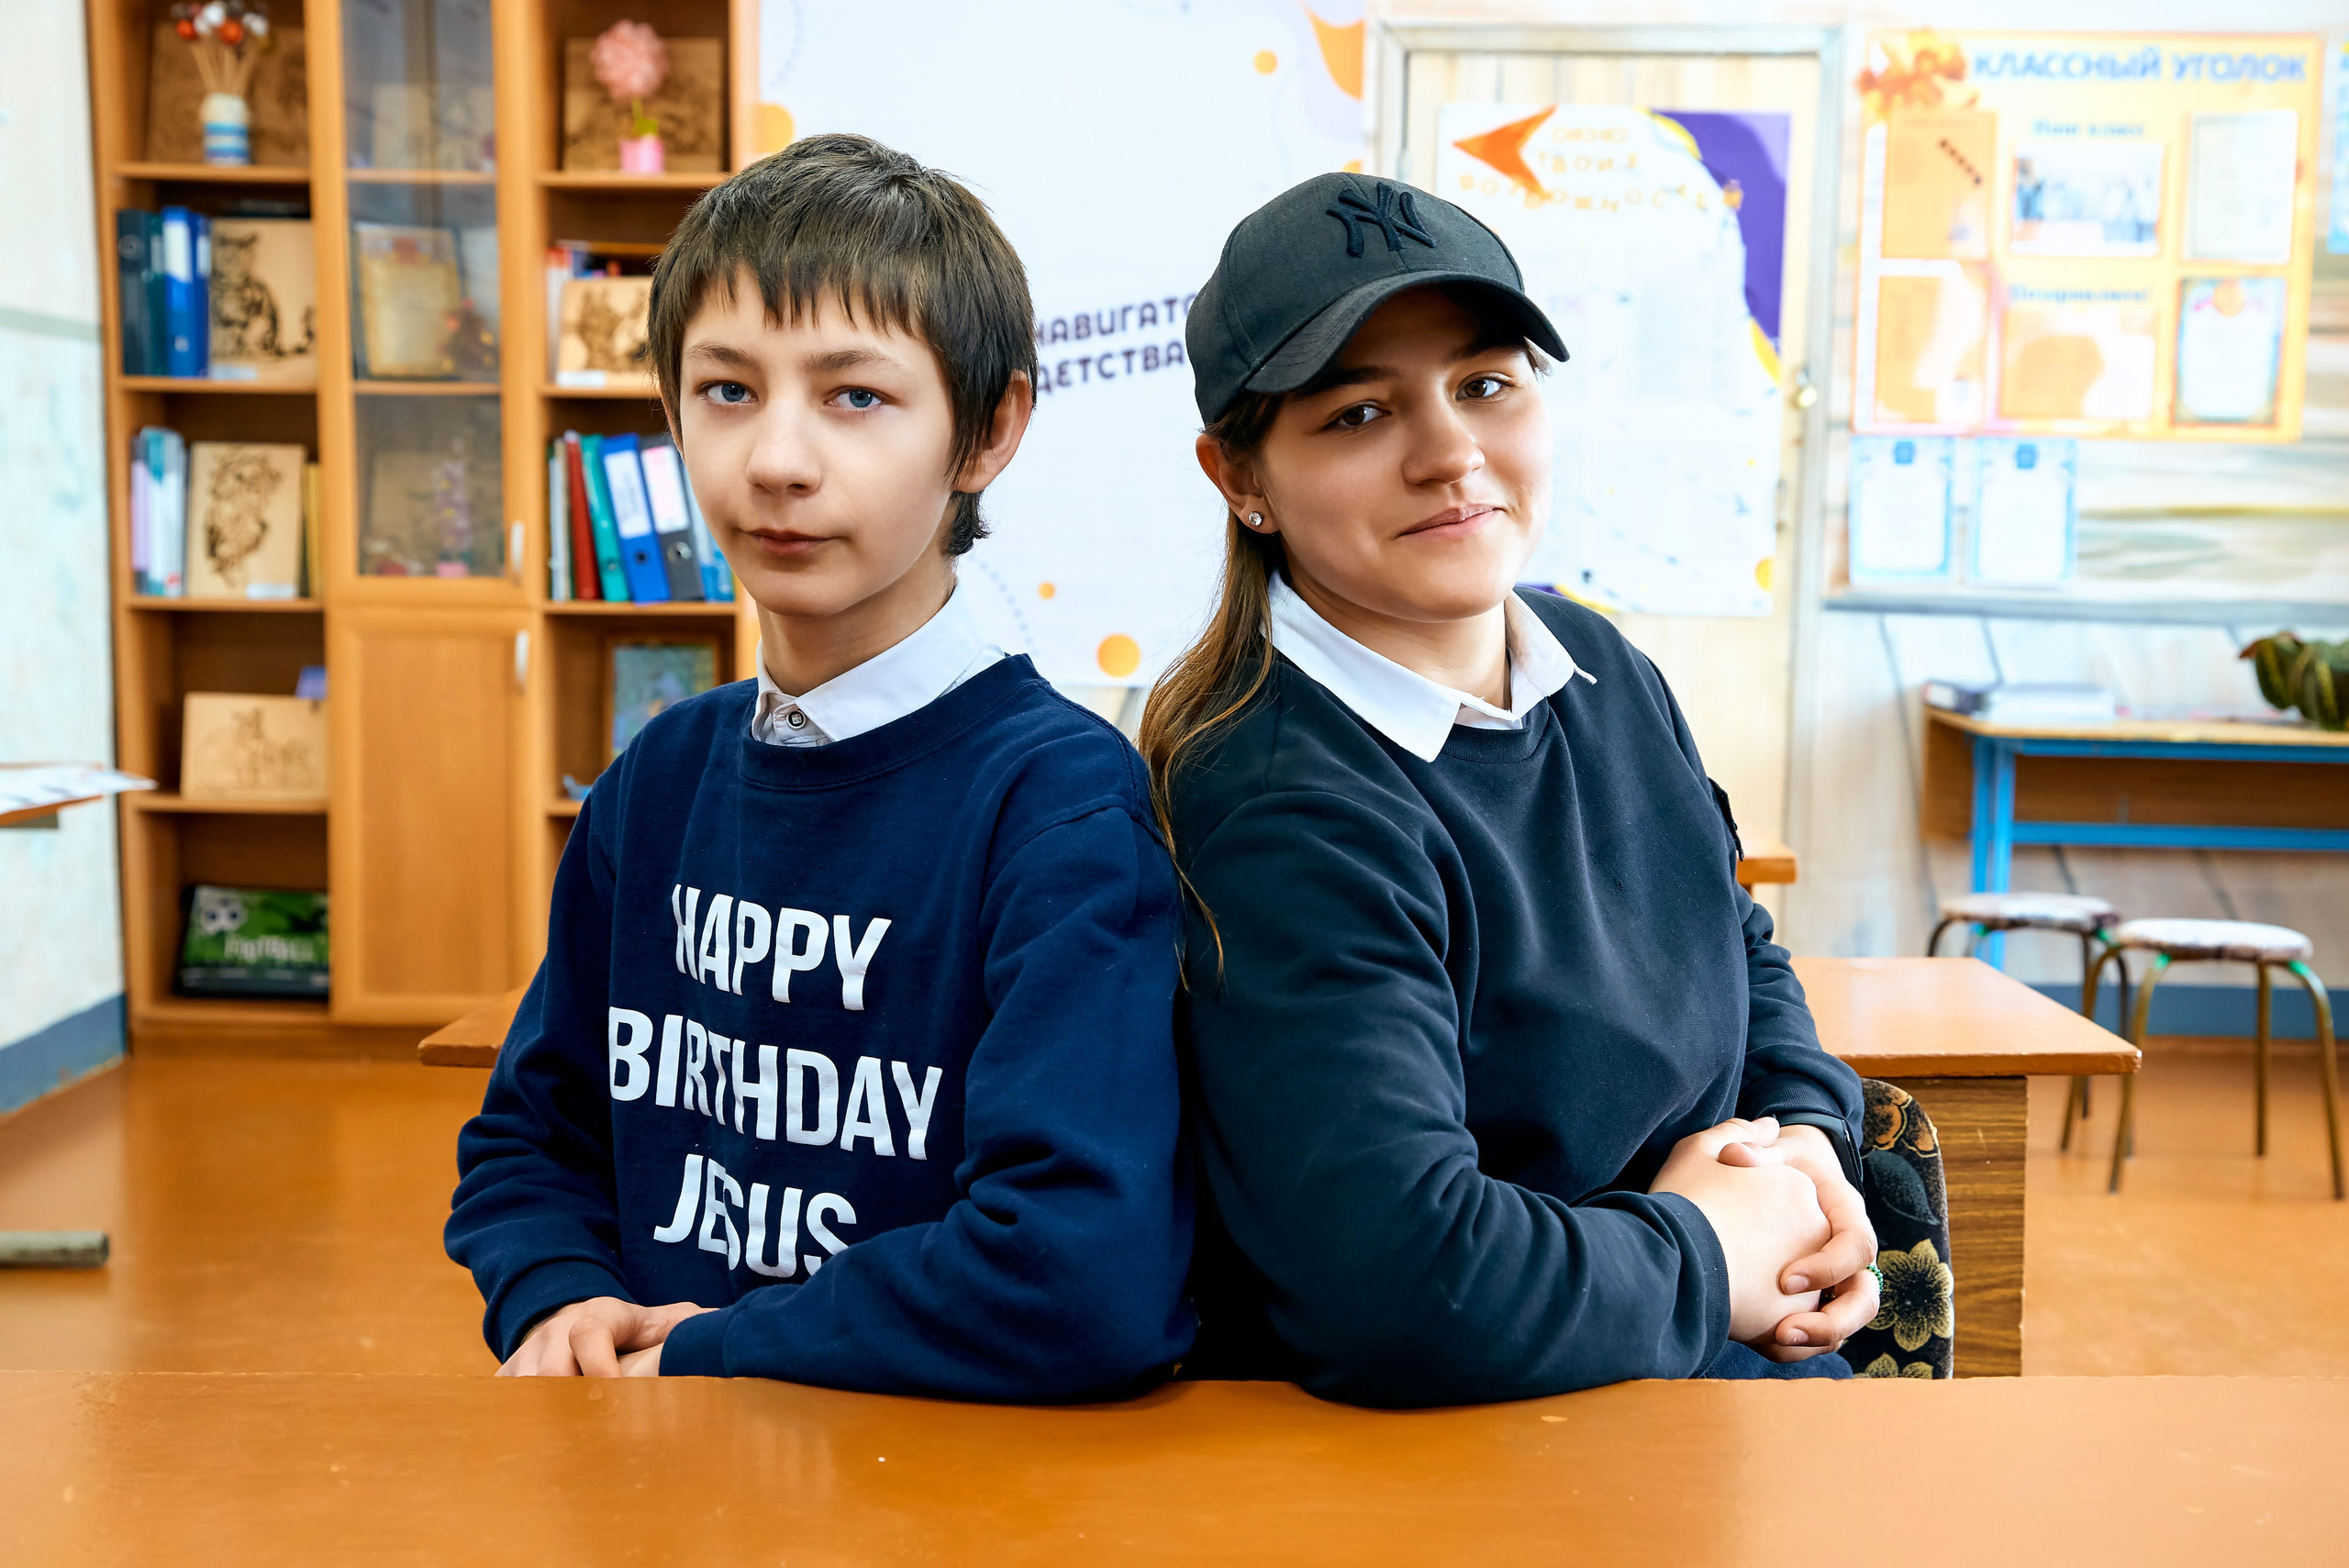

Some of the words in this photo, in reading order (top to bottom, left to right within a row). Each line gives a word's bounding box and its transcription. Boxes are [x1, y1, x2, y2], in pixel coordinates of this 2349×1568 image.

[1973, 45, 2164, 82] КЛАССНЫЙ
[2171, 52, 2308, 83] УГОЛОК
[672, 884, 892, 1011] HAPPY
[608, 1006, 943, 1160] BIRTHDAY
[653, 1153, 858, 1278] JESUS
